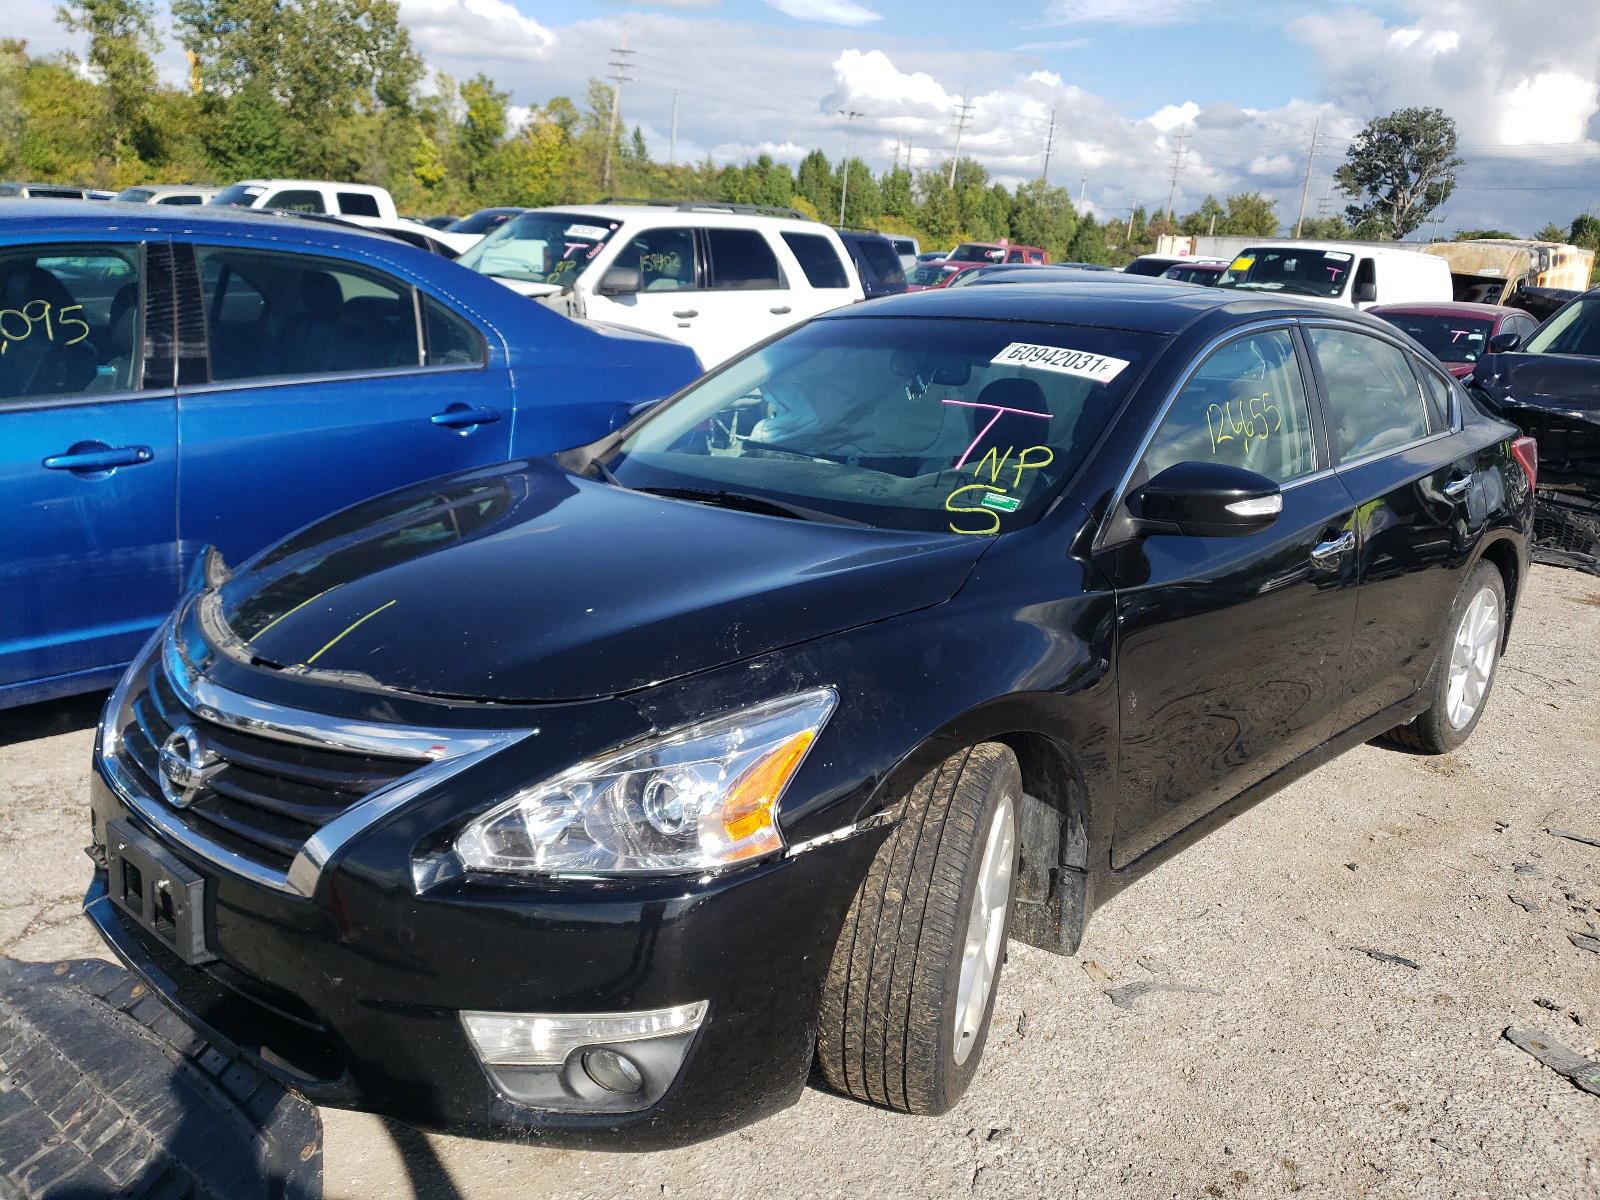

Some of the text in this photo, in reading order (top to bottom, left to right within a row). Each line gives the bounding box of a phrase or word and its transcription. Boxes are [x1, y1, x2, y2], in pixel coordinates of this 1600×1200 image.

[1327, 266, 1343, 281] T
[1450, 329, 1470, 343] T
[941, 399, 1054, 470] T
[974, 445, 1054, 488] NP
[945, 483, 1007, 535] S
